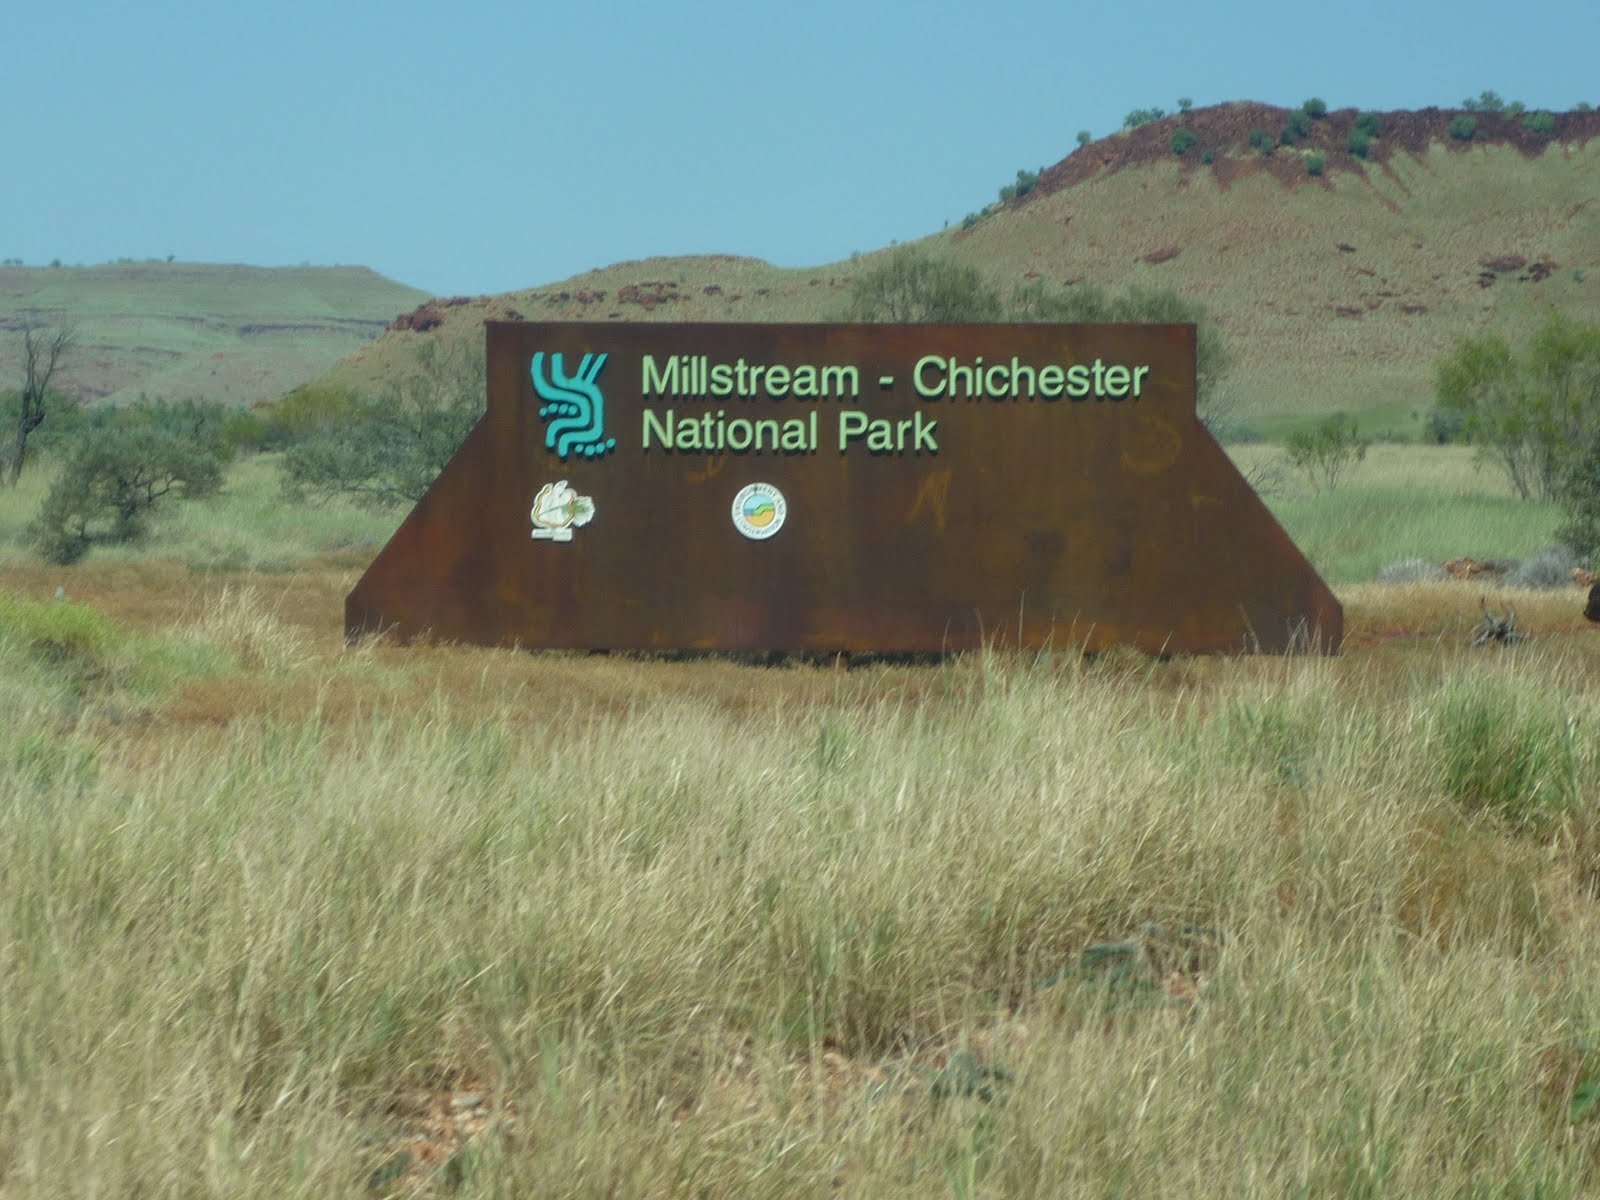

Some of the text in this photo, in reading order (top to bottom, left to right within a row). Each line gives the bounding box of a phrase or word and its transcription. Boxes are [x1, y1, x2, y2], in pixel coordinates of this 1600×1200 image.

[641, 354, 859, 396] Millstream
[913, 354, 1150, 397] Chichester
[641, 408, 938, 451] National Park
